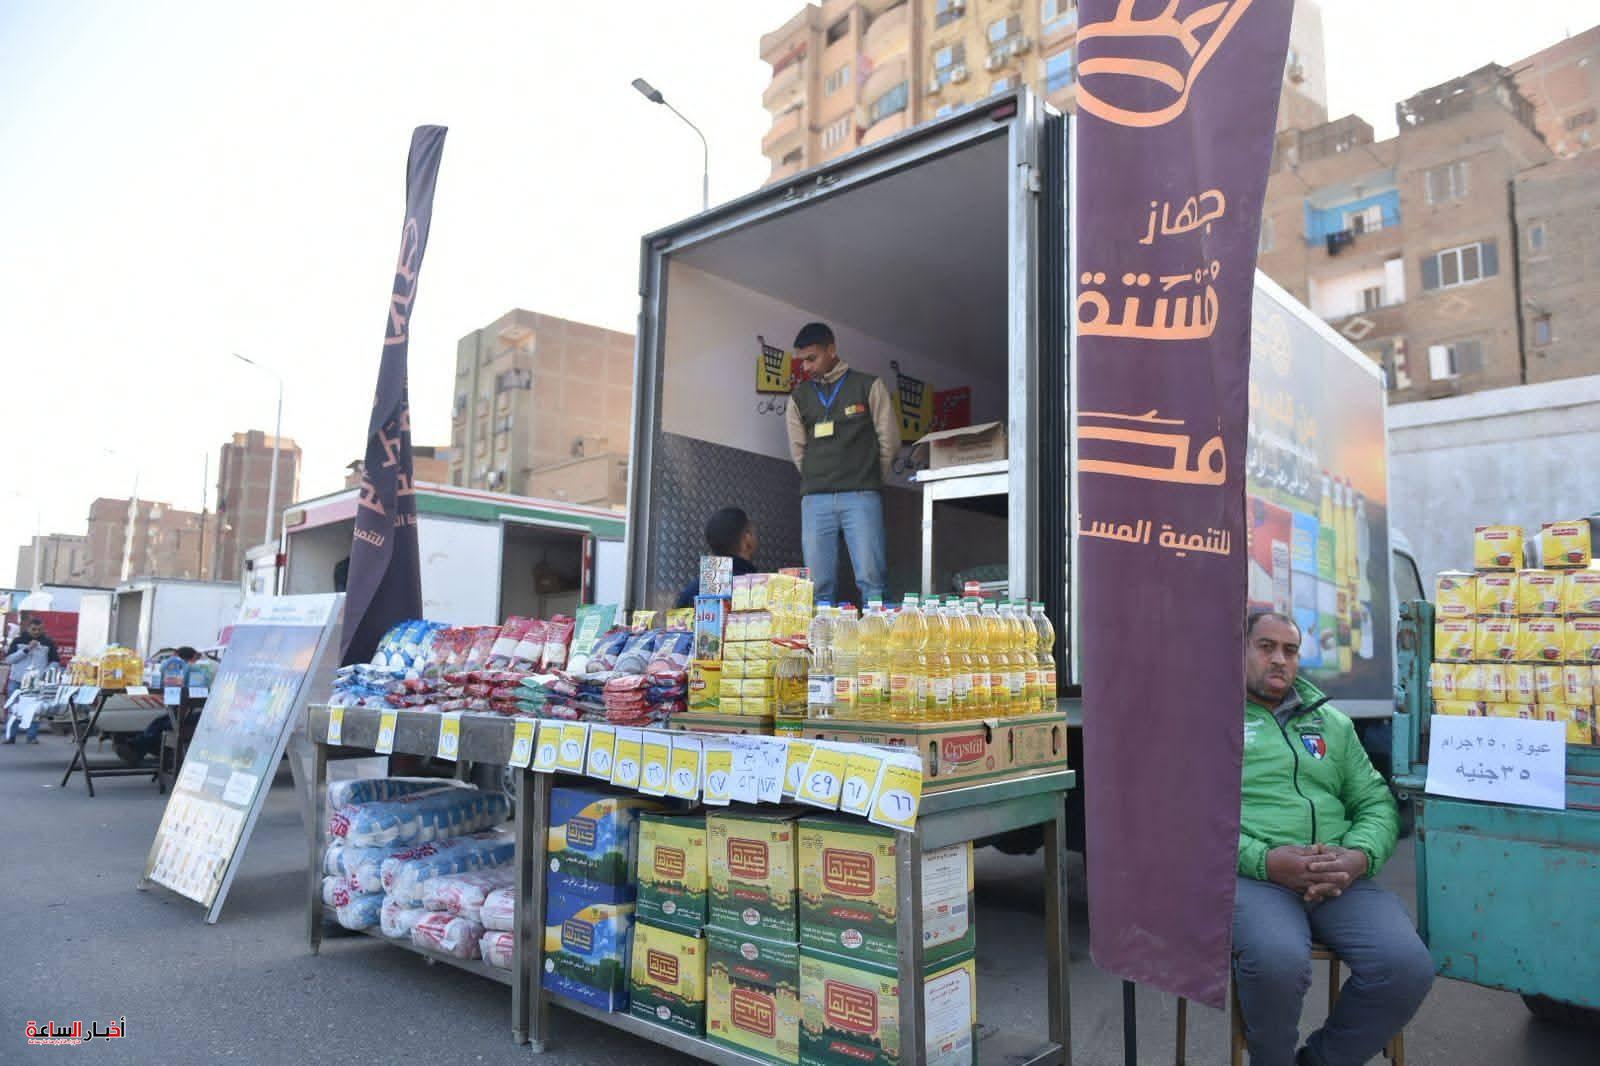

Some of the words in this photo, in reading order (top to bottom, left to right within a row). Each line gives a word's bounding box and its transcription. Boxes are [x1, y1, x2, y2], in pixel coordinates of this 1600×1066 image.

[1139, 189, 1225, 245] جهاز
[1159, 524, 1231, 557] للتنمية
[1515, 738, 1552, 757] عبوة
[811, 773, 833, 796] ٤٩
[847, 781, 862, 800] ٦١
[889, 794, 912, 812] ٦٦
